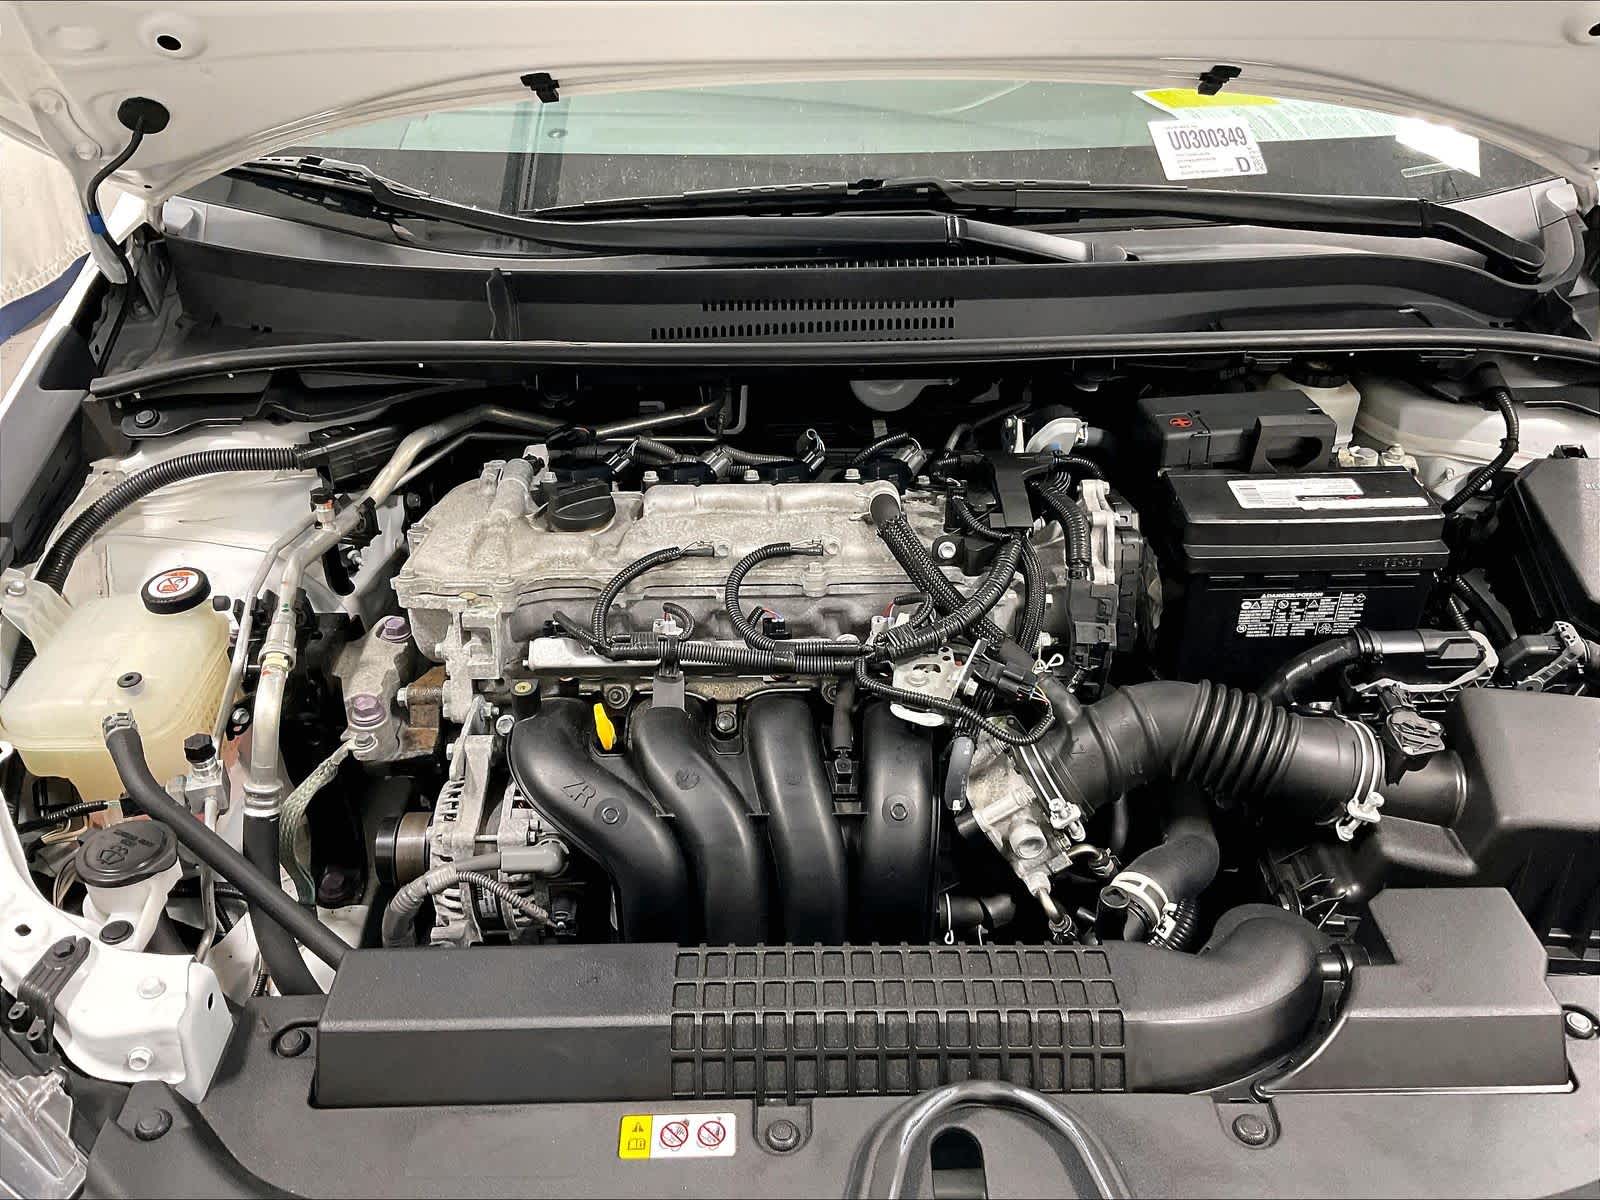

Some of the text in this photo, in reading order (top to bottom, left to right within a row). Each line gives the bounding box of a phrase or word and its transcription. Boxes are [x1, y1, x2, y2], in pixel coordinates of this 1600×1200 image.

[1167, 127, 1248, 150] U0300349
[1235, 156, 1251, 172] D
[561, 778, 597, 808] ZR
